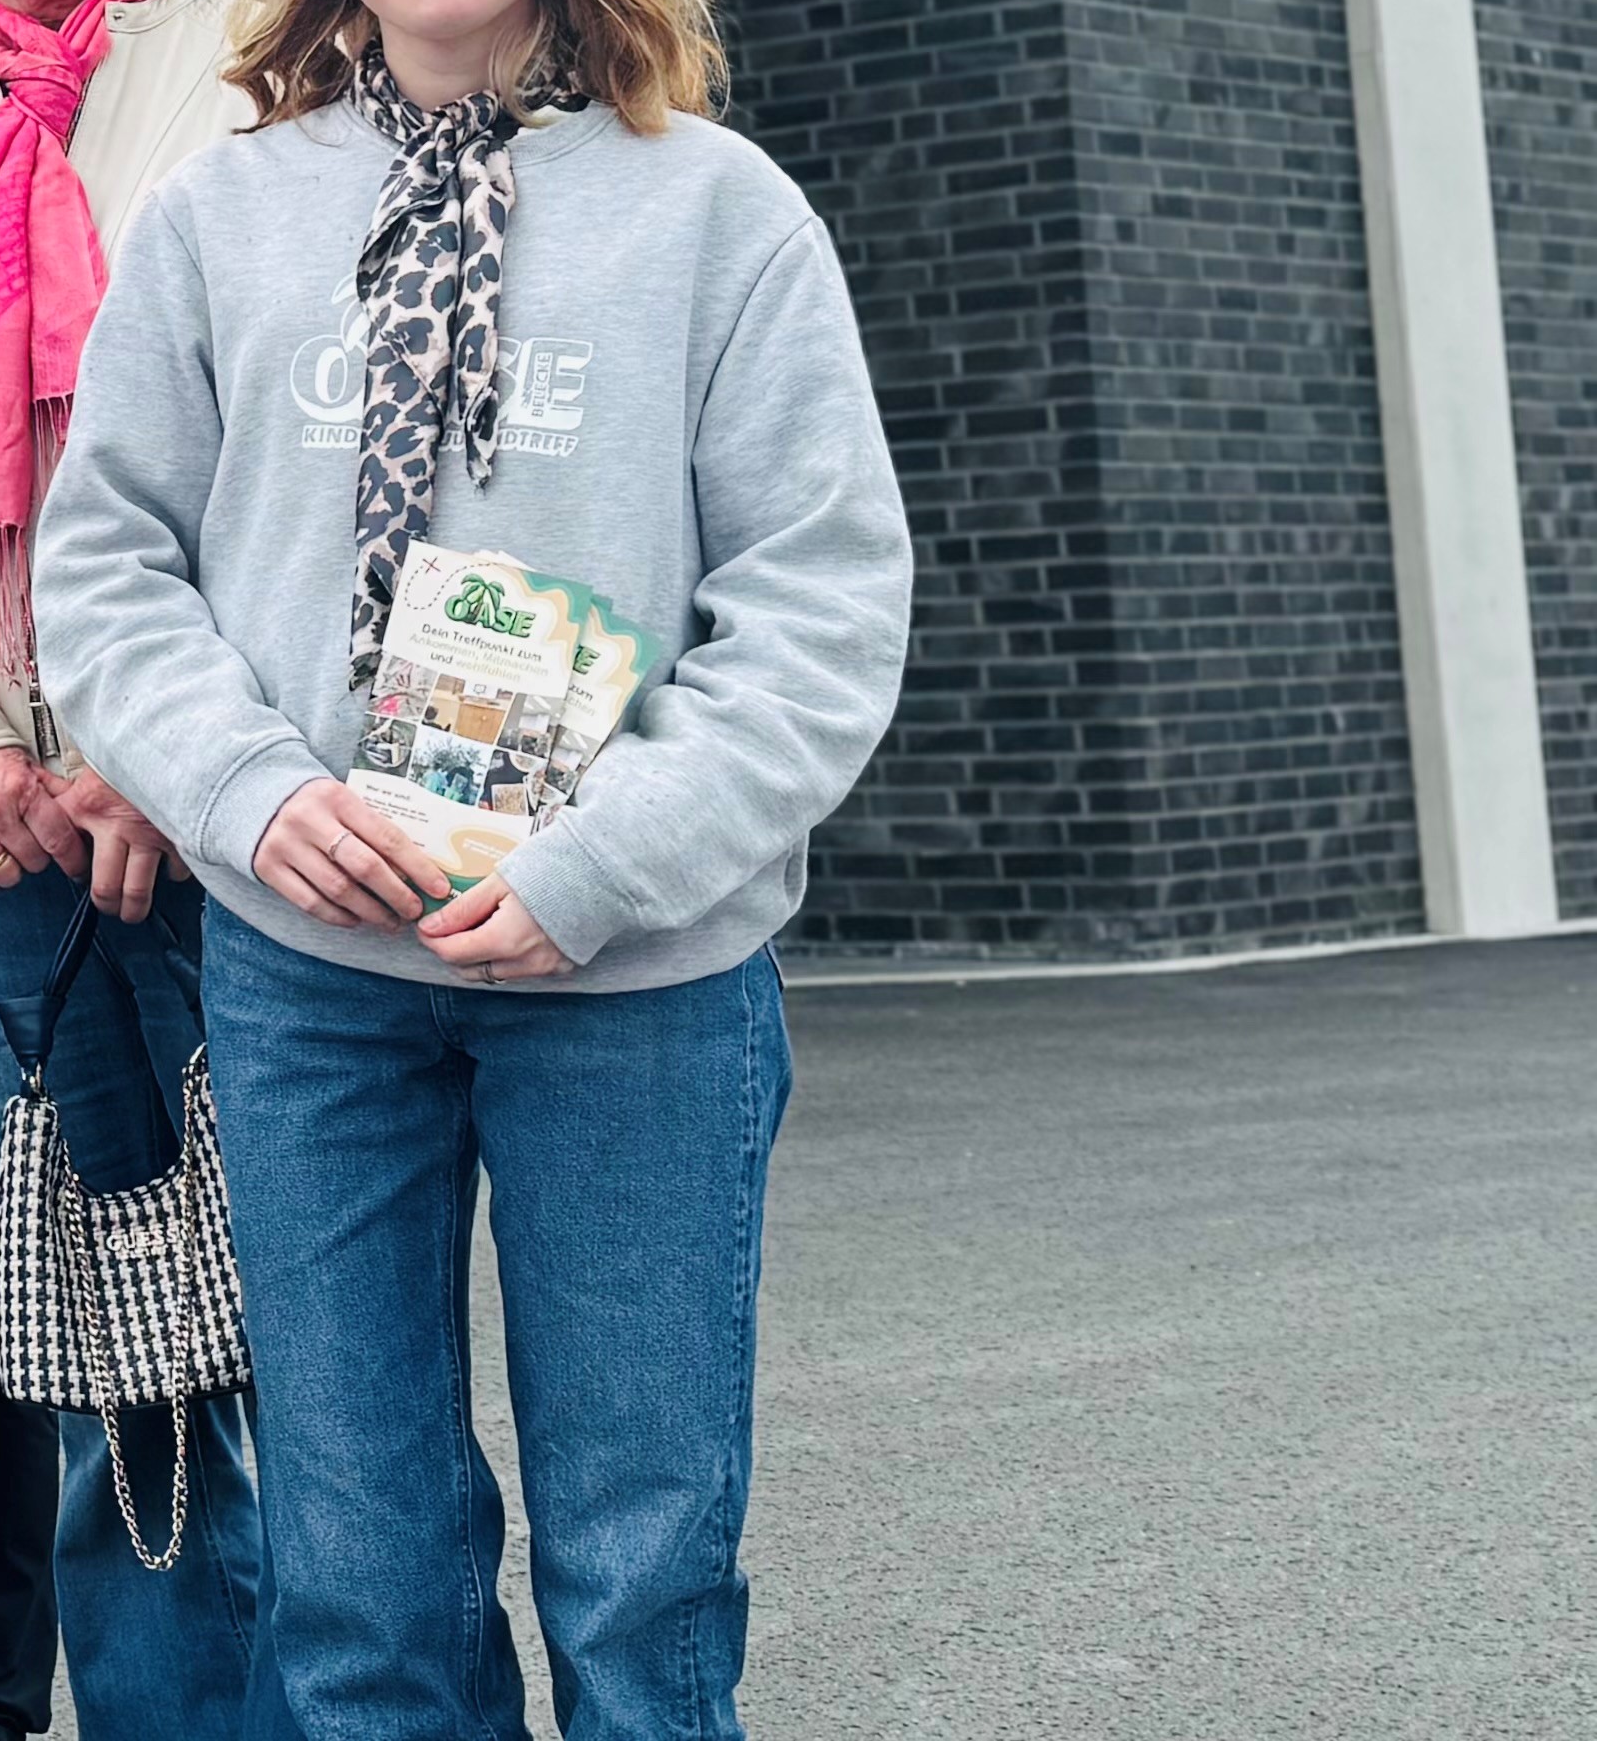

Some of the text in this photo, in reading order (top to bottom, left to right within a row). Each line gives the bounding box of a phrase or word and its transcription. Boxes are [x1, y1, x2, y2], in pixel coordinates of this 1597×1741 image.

[303, 427, 358, 444] KIND
[444, 595, 537, 638] OASE
[421, 623, 542, 662] Dein Treffpunkt zum
[430, 651, 454, 664] und
